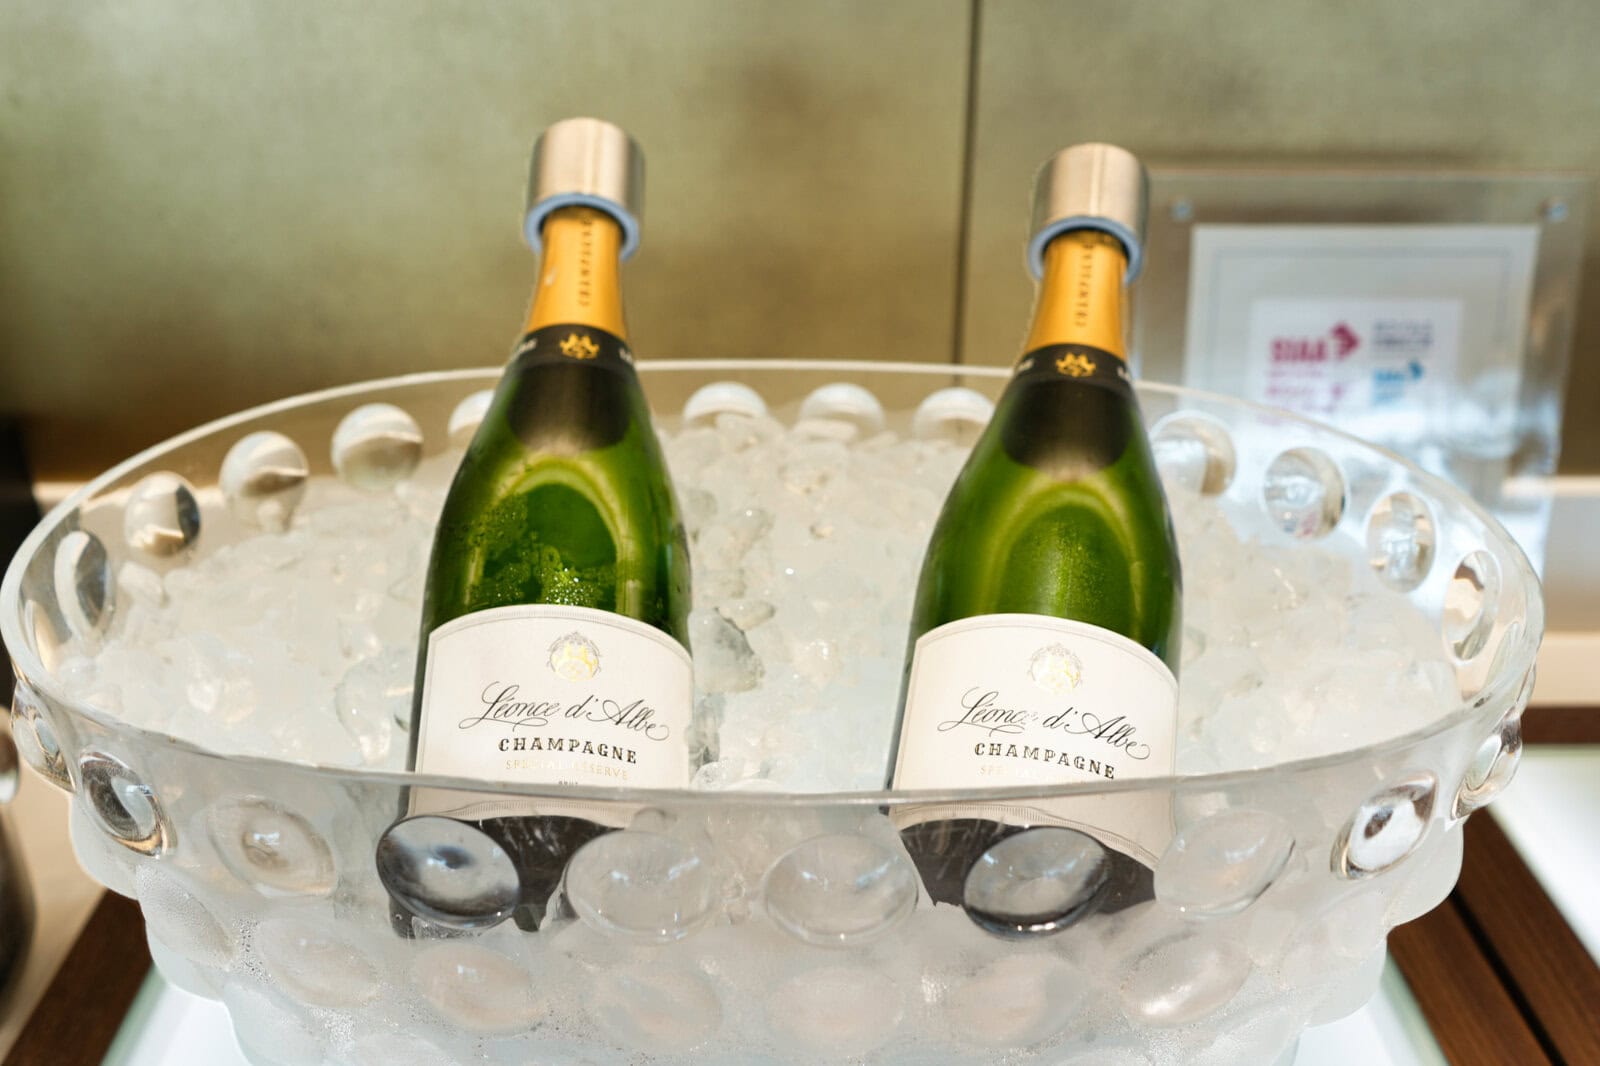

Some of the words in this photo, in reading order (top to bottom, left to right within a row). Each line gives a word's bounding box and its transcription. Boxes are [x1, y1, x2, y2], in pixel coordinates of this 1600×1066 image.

[458, 681, 560, 732] Léonce
[498, 736, 637, 764] CHAMPAGNE
[974, 742, 1115, 779] CHAMPAGNE
